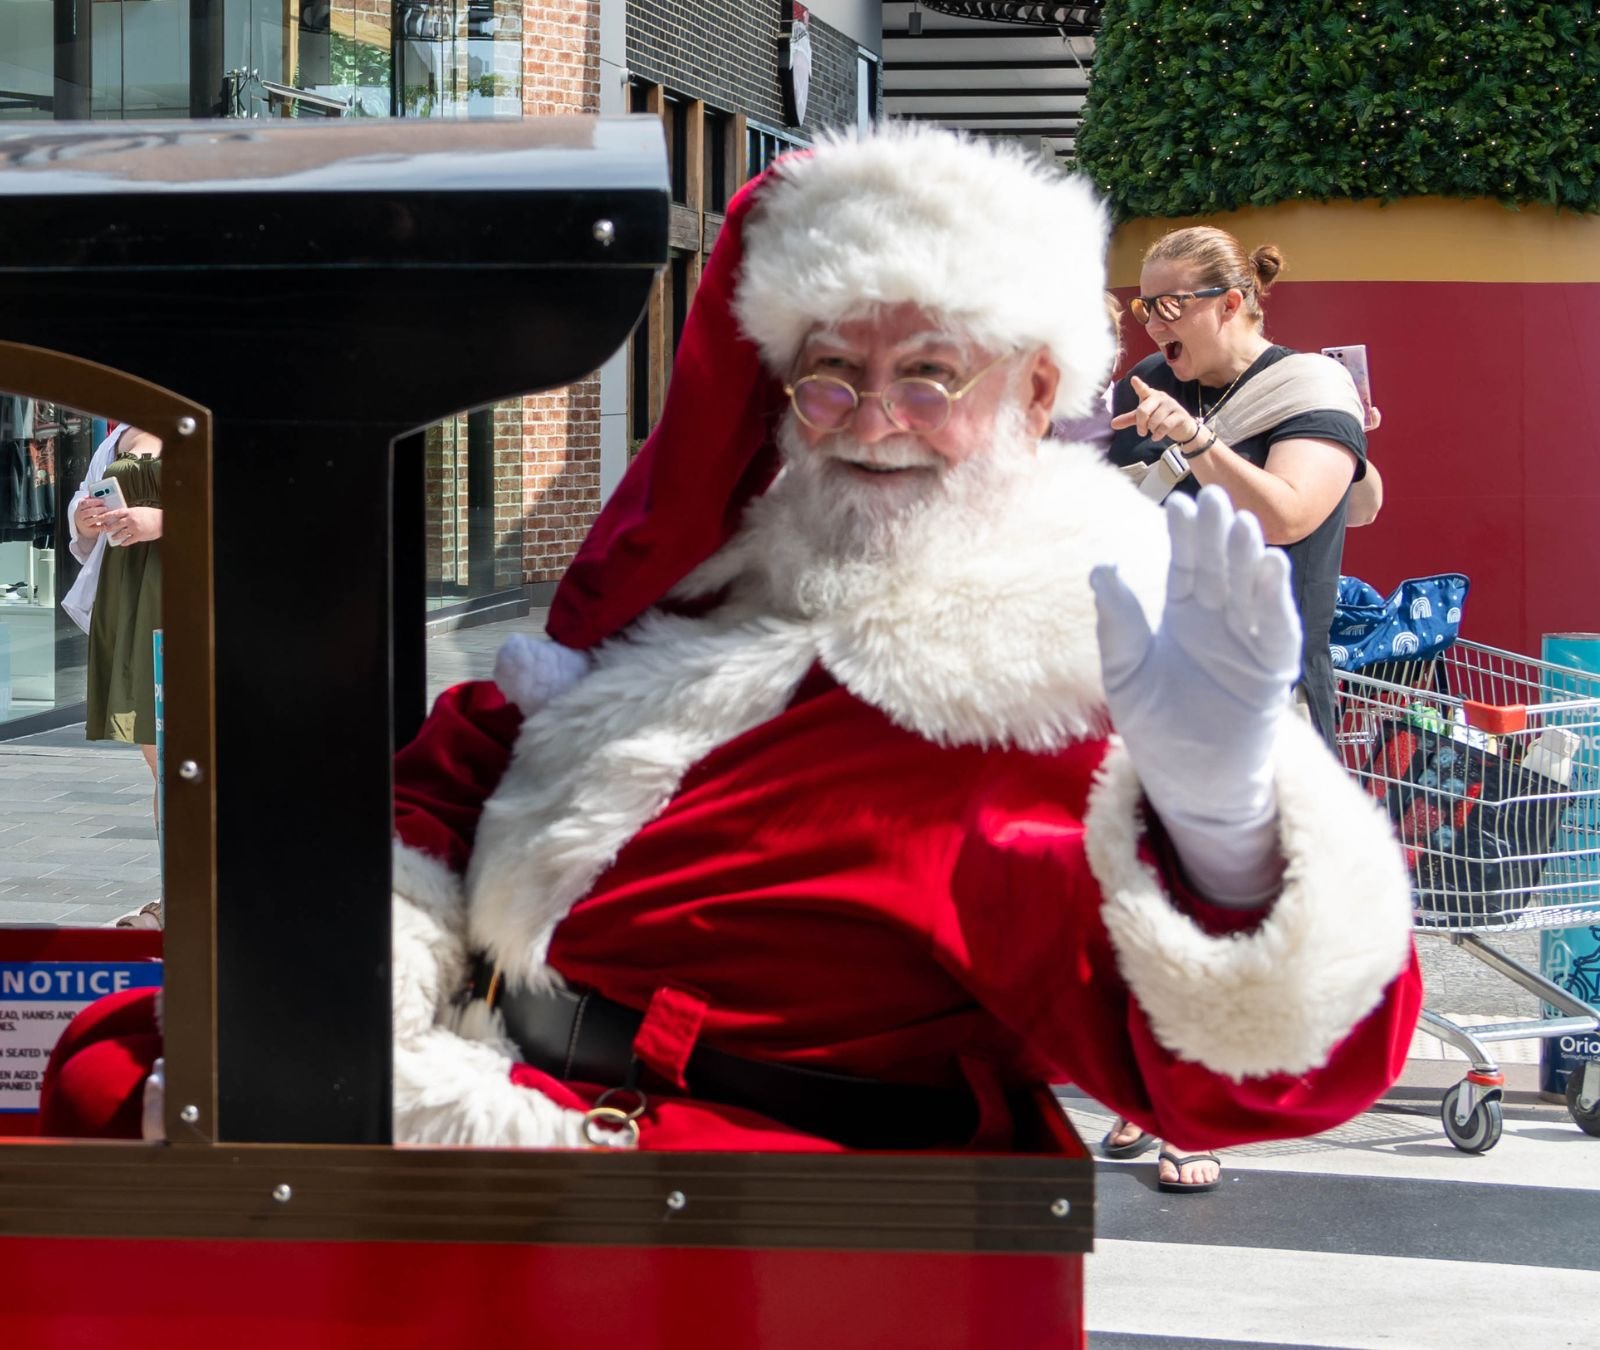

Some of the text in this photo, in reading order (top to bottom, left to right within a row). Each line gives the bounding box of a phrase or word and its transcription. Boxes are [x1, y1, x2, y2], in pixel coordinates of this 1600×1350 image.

[2, 970, 131, 994] NOTICE
[22, 1010, 55, 1020] HANDS
[6, 1048, 41, 1058] SEATED
[14, 1071, 38, 1080] AGED
